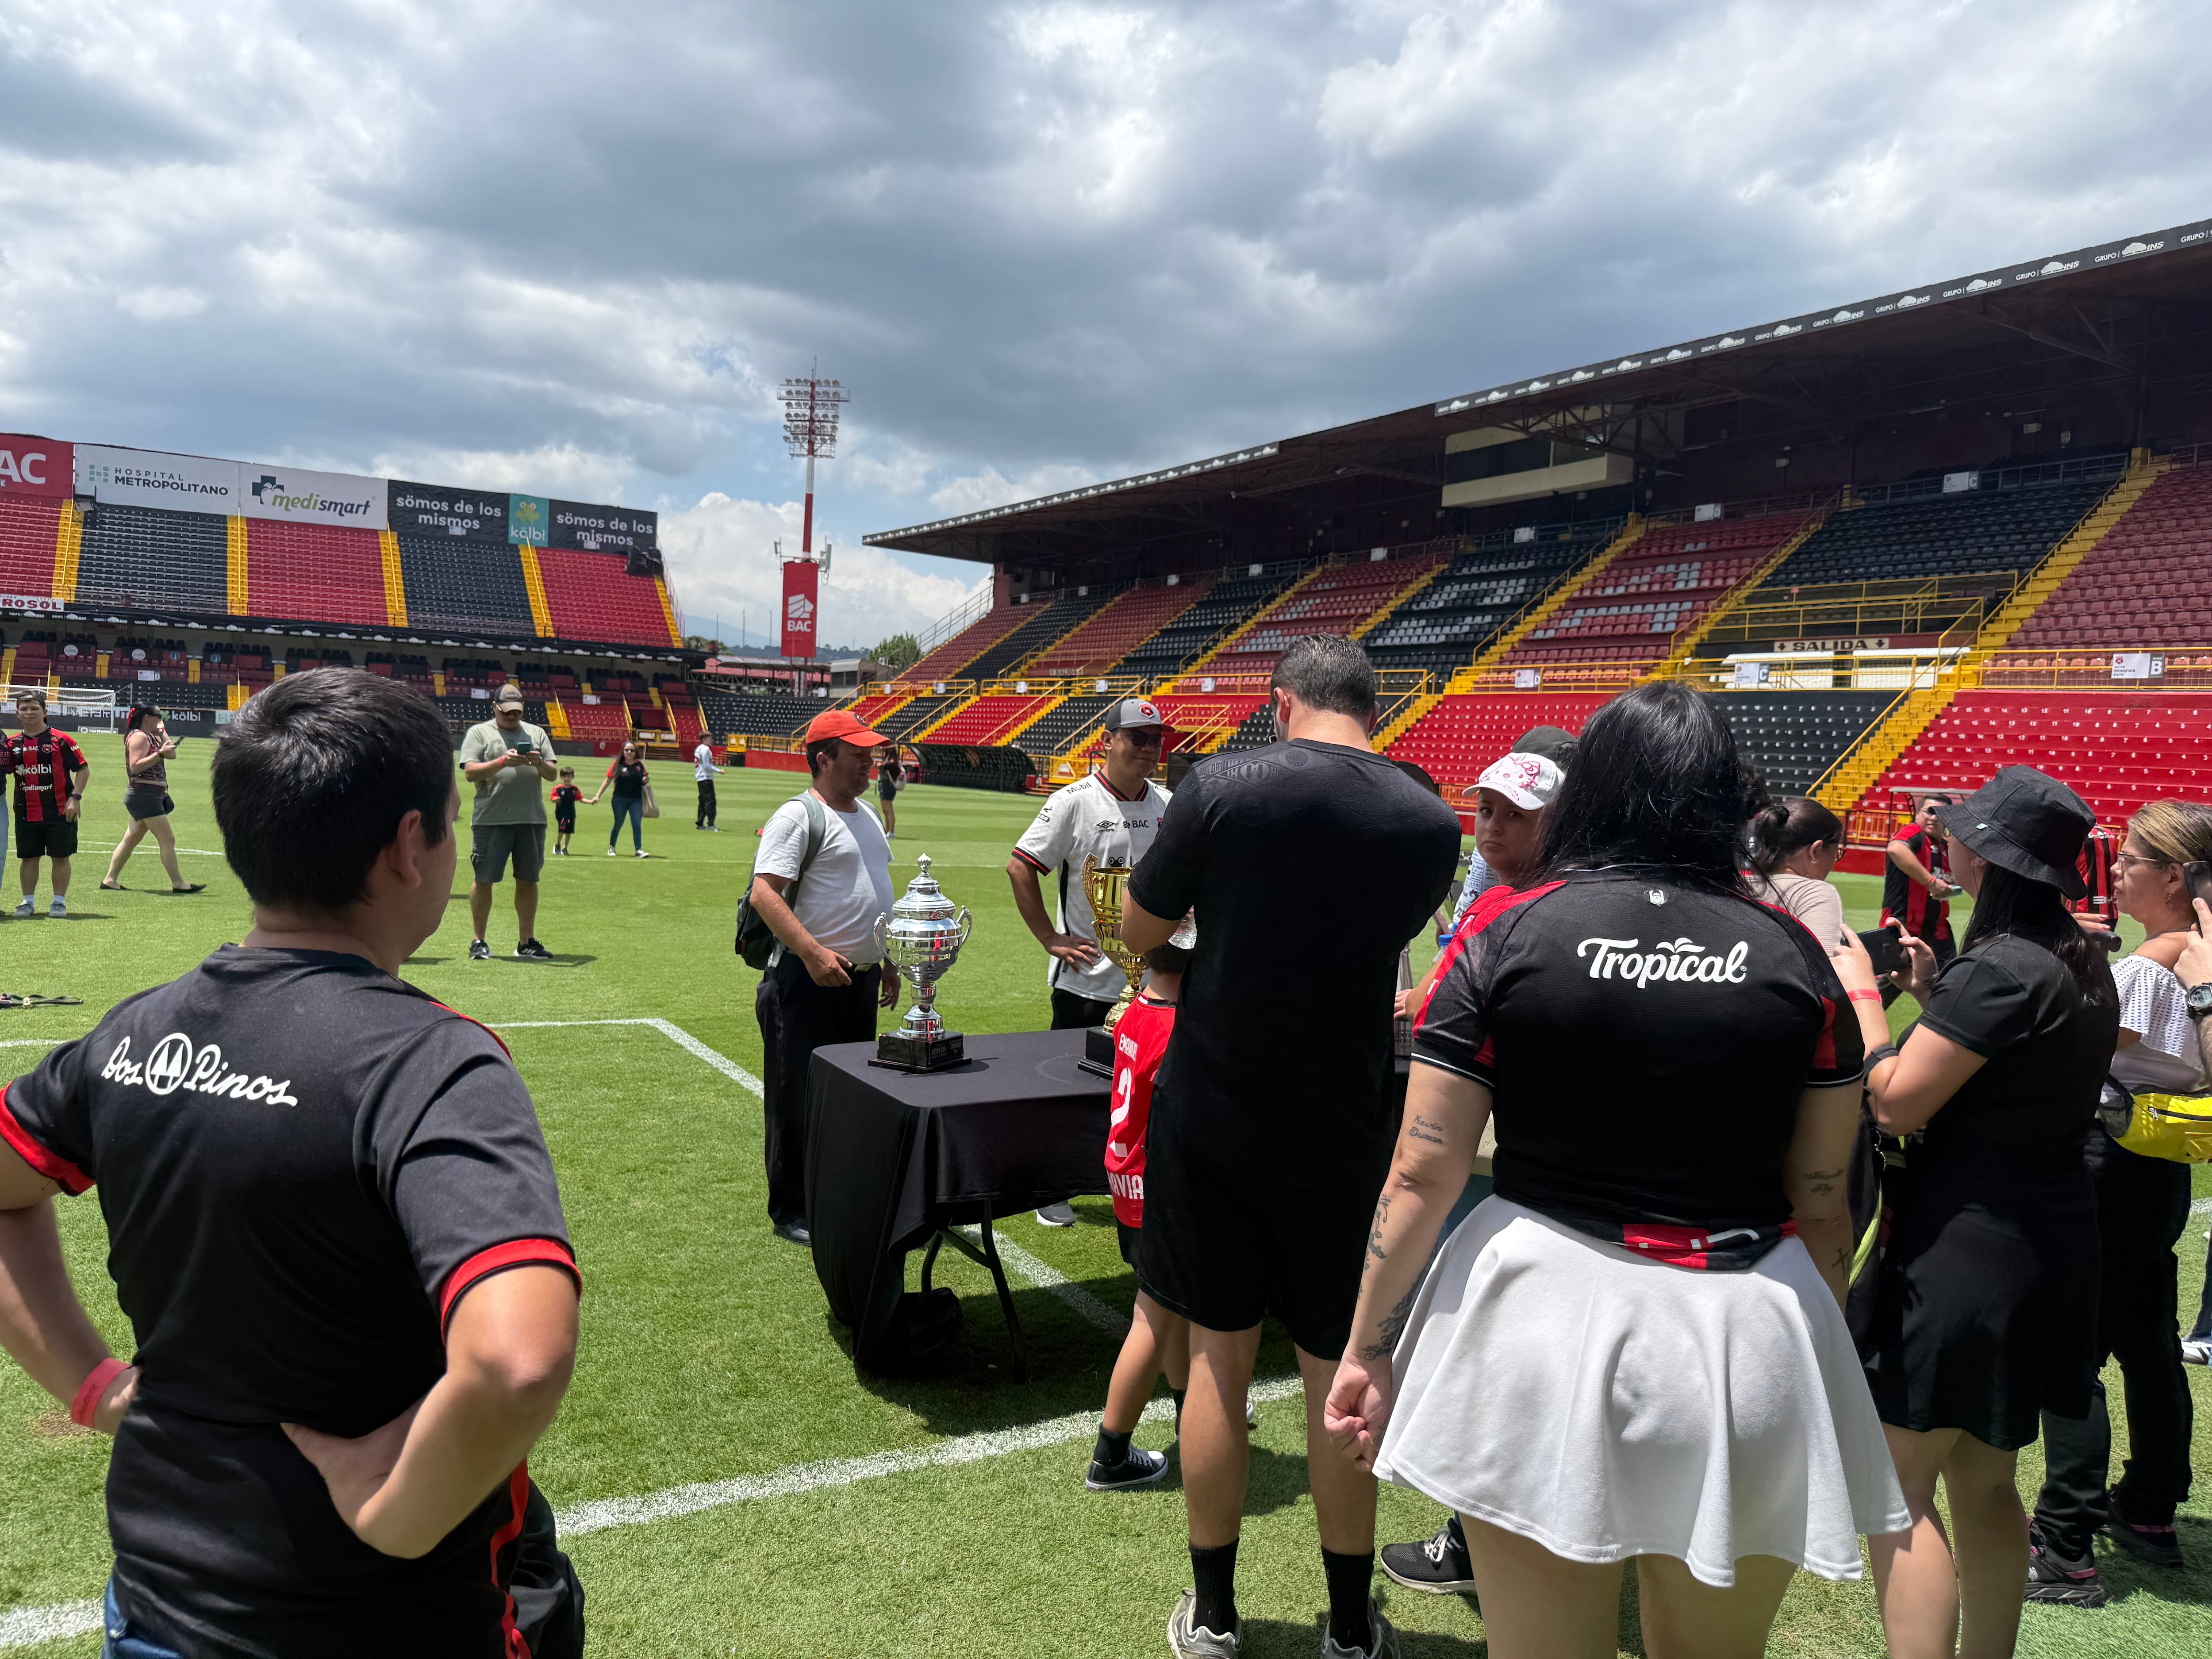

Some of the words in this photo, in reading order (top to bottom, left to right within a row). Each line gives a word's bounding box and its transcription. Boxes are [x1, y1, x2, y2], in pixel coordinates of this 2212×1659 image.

[2181, 232, 2204, 243] GRUPO
[2094, 252, 2116, 262] GRUPO
[2147, 241, 2164, 251] INS
[2016, 271, 2036, 280] GRUPO
[2063, 261, 2079, 270] INS
[1943, 288, 1962, 297] GRUPO
[1987, 279, 2002, 288] INS
[1875, 304, 1893, 313] GRUPO
[1916, 295, 1930, 304] INS
[1851, 311, 1864, 319] INS
[0, 450, 46, 484] AC
[115, 467, 184, 481] HOSPITAL
[115, 476, 228, 495] METROPOLITANO
[271, 492, 370, 516] medismart
[396, 495, 449, 511] sömos
[454, 499, 474, 514] de
[480, 502, 502, 517] los
[418, 512, 480, 530] mismos
[557, 512, 605, 529] sömos
[610, 517, 627, 531] de
[633, 519, 653, 534] los
[511, 525, 545, 541] kölbi
[577, 530, 634, 546] mismos
[2, 598, 61, 611] ROSOL
[787, 620, 811, 632] BAC
[1792, 640, 1868, 651] SALIDA
[1759, 668, 1768, 681] C
[2151, 661, 2162, 675] B
[172, 711, 201, 722] kölbi
[25, 764, 52, 774] kölbi
[1066, 782, 1091, 795] Mobil
[1577, 937, 1748, 989] Tropical
[101, 1036, 143, 1086] Los
[183, 1044, 298, 1106] Pinos
[1111, 1067, 1132, 1158] 2
[1106, 1171, 1144, 1199] AVIA
